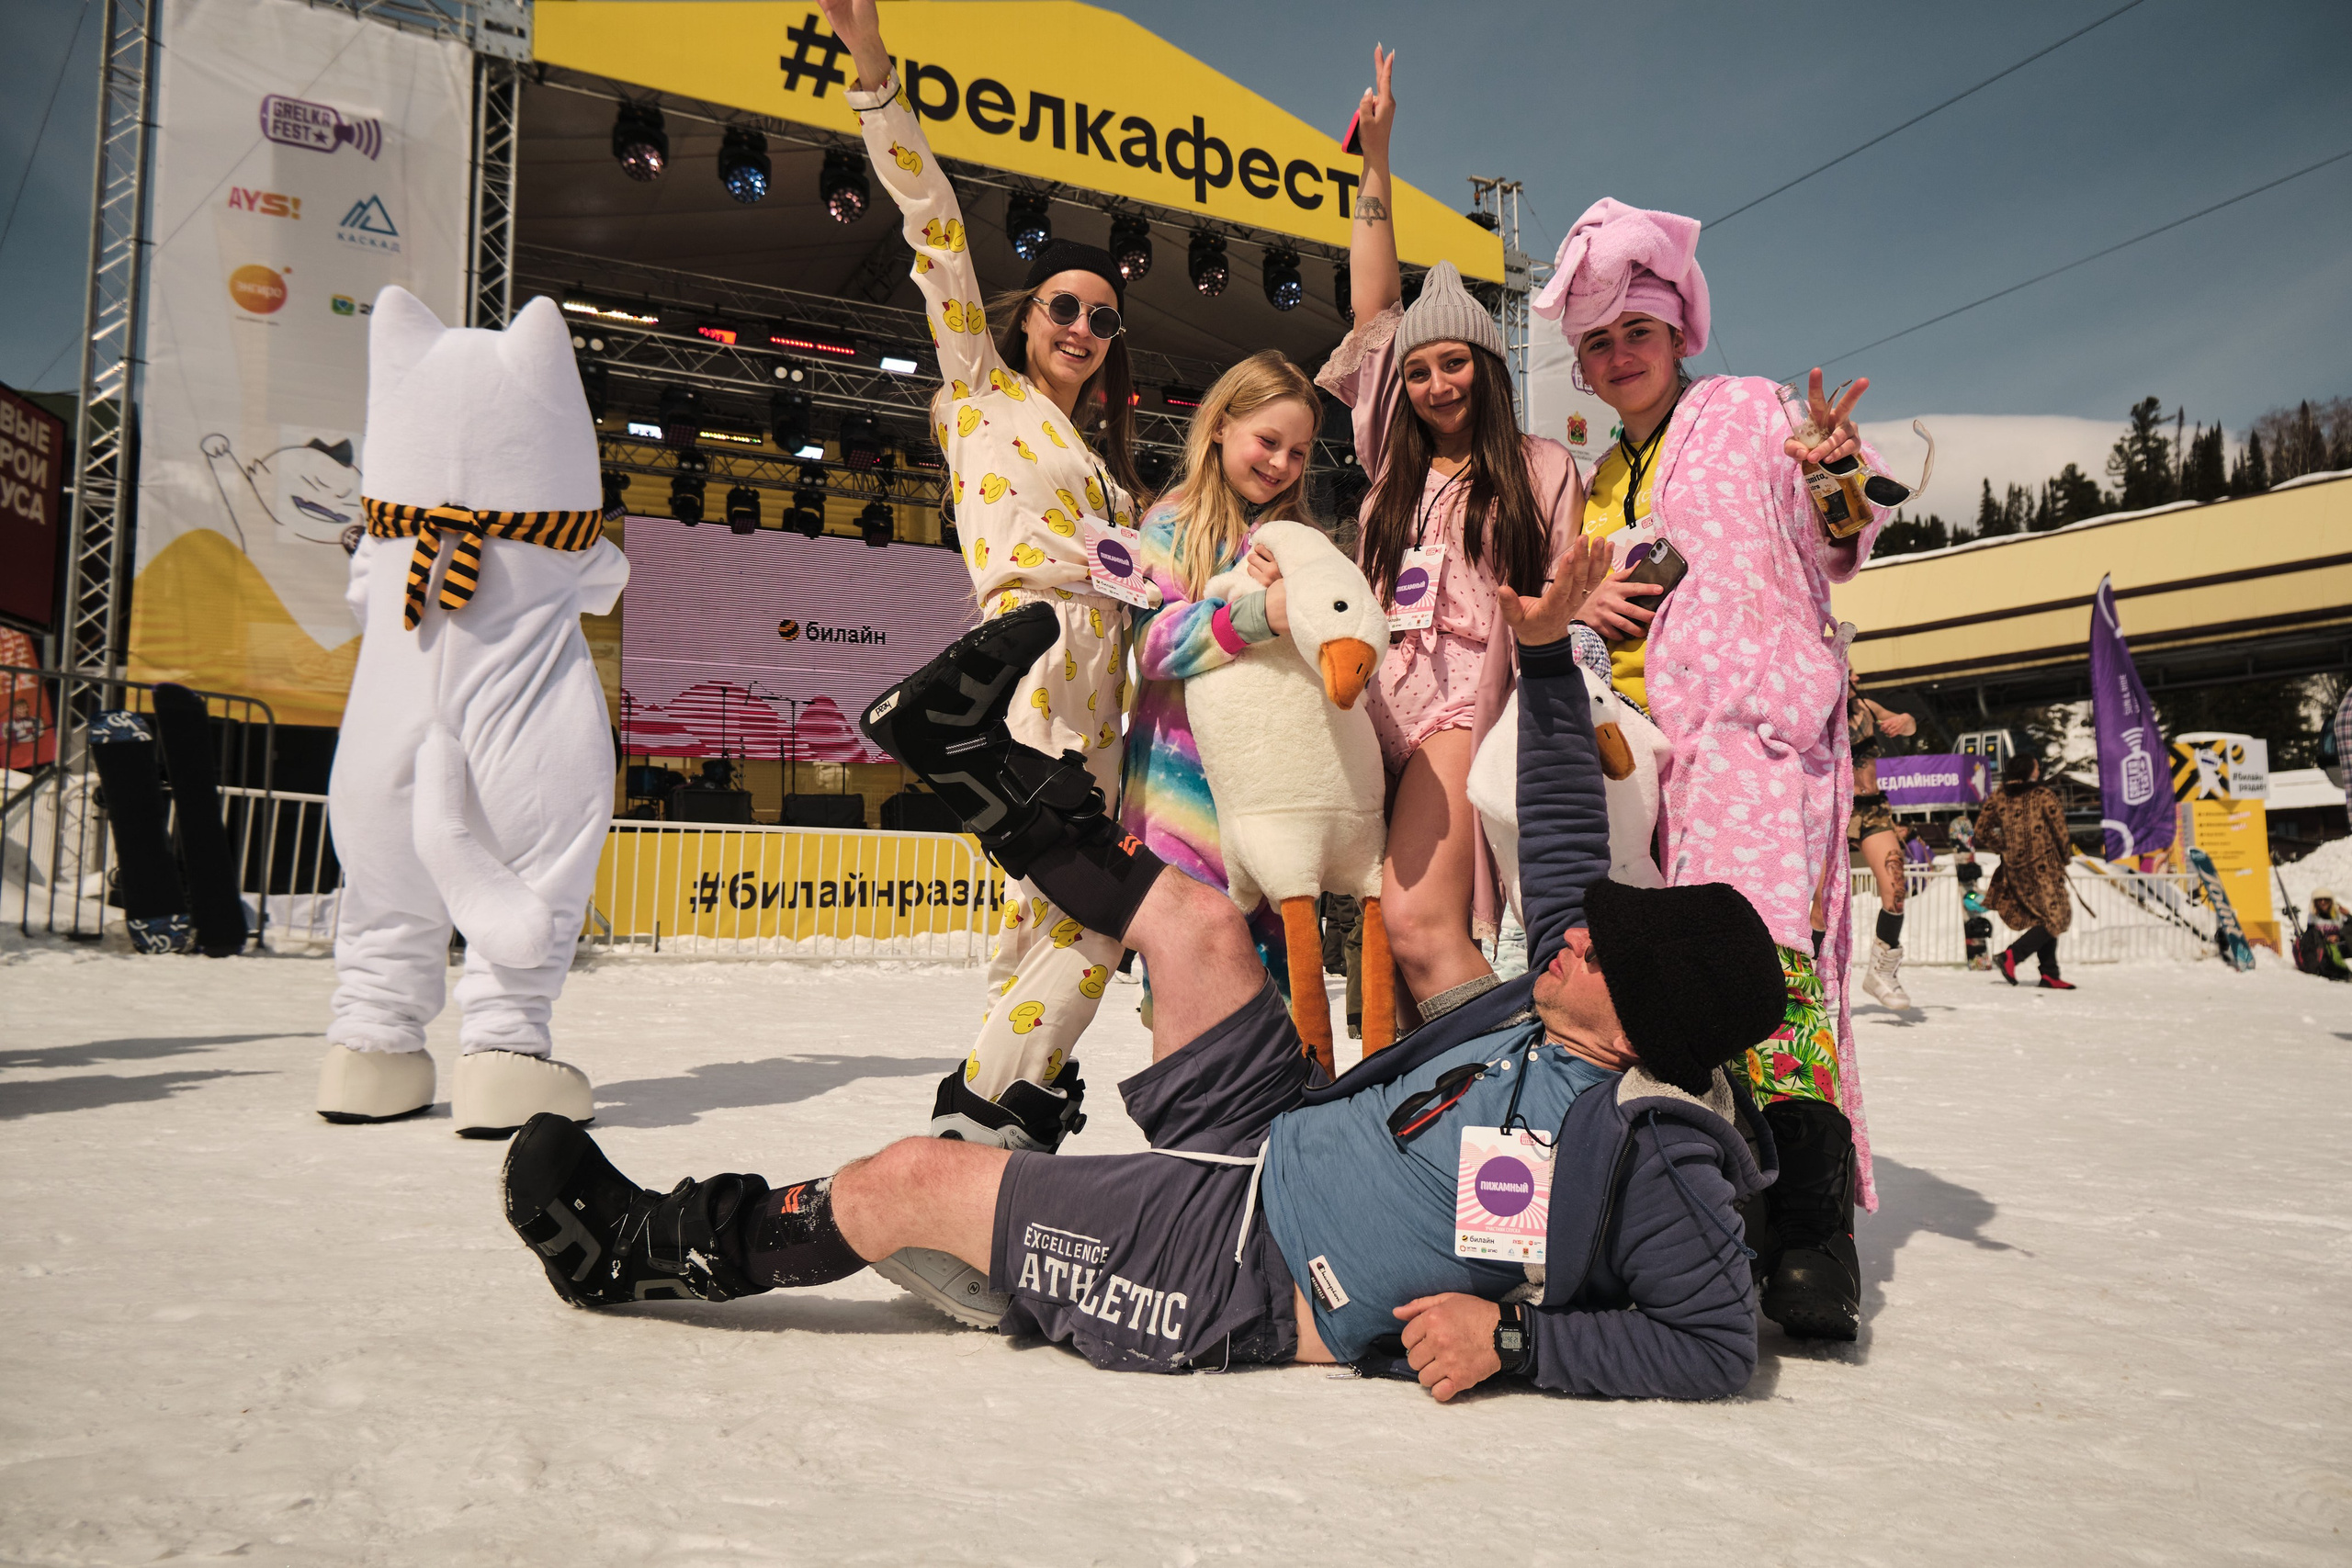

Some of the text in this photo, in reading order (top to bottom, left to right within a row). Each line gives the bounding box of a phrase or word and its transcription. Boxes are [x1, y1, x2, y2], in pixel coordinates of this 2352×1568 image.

[273, 102, 331, 127] GRELKA
[779, 14, 1360, 219] #релкафест
[273, 118, 311, 141] FEST
[228, 186, 301, 220] AYS!
[336, 231, 401, 254] КАСКАД
[806, 621, 886, 645] билайн
[690, 870, 1005, 917] #билайнразд
[1480, 1180, 1529, 1193] ПИЖАМНЫЙ
[1023, 1226, 1110, 1264] EXCELLENCE
[1469, 1235, 1495, 1245] билайн
[1018, 1252, 1188, 1339] ATHLETIC
[1317, 1261, 1340, 1303] Champion
